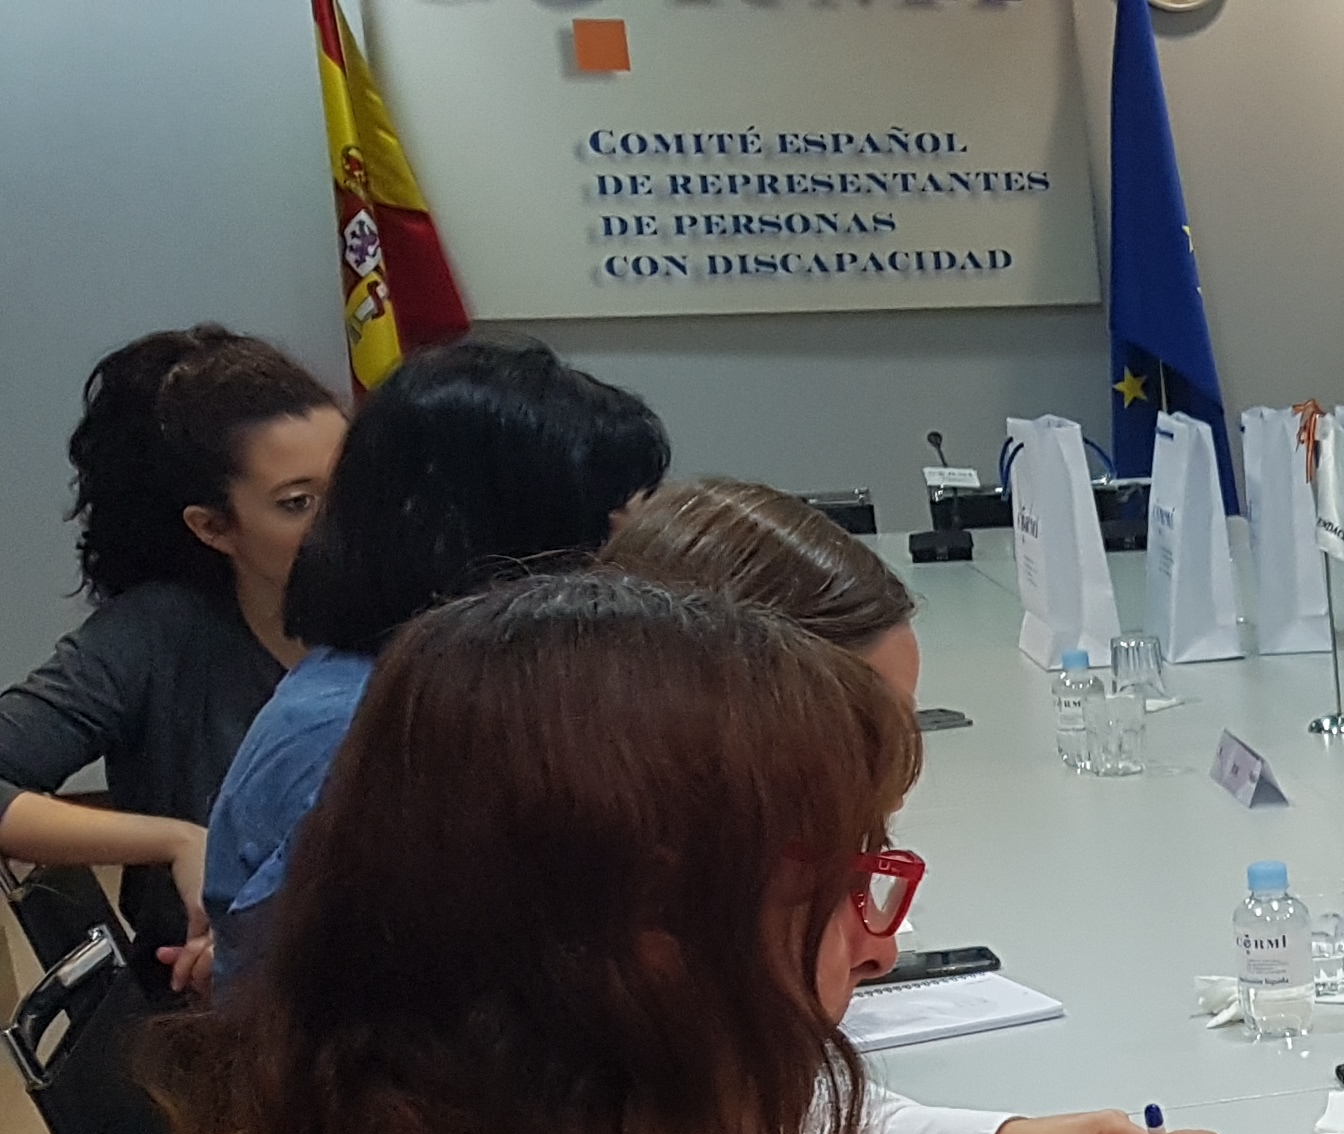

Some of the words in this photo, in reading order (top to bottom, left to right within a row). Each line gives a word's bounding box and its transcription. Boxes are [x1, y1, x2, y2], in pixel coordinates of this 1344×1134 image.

[588, 125, 762, 155] COMITÉ
[777, 126, 968, 154] ESPAÑOL
[596, 173, 654, 196] DE
[668, 170, 1051, 195] REPRESENTANTES
[602, 214, 658, 237] DE
[674, 211, 897, 235] PERSONAS
[604, 254, 689, 278] CON
[707, 249, 1013, 275] DISCAPACIDAD
